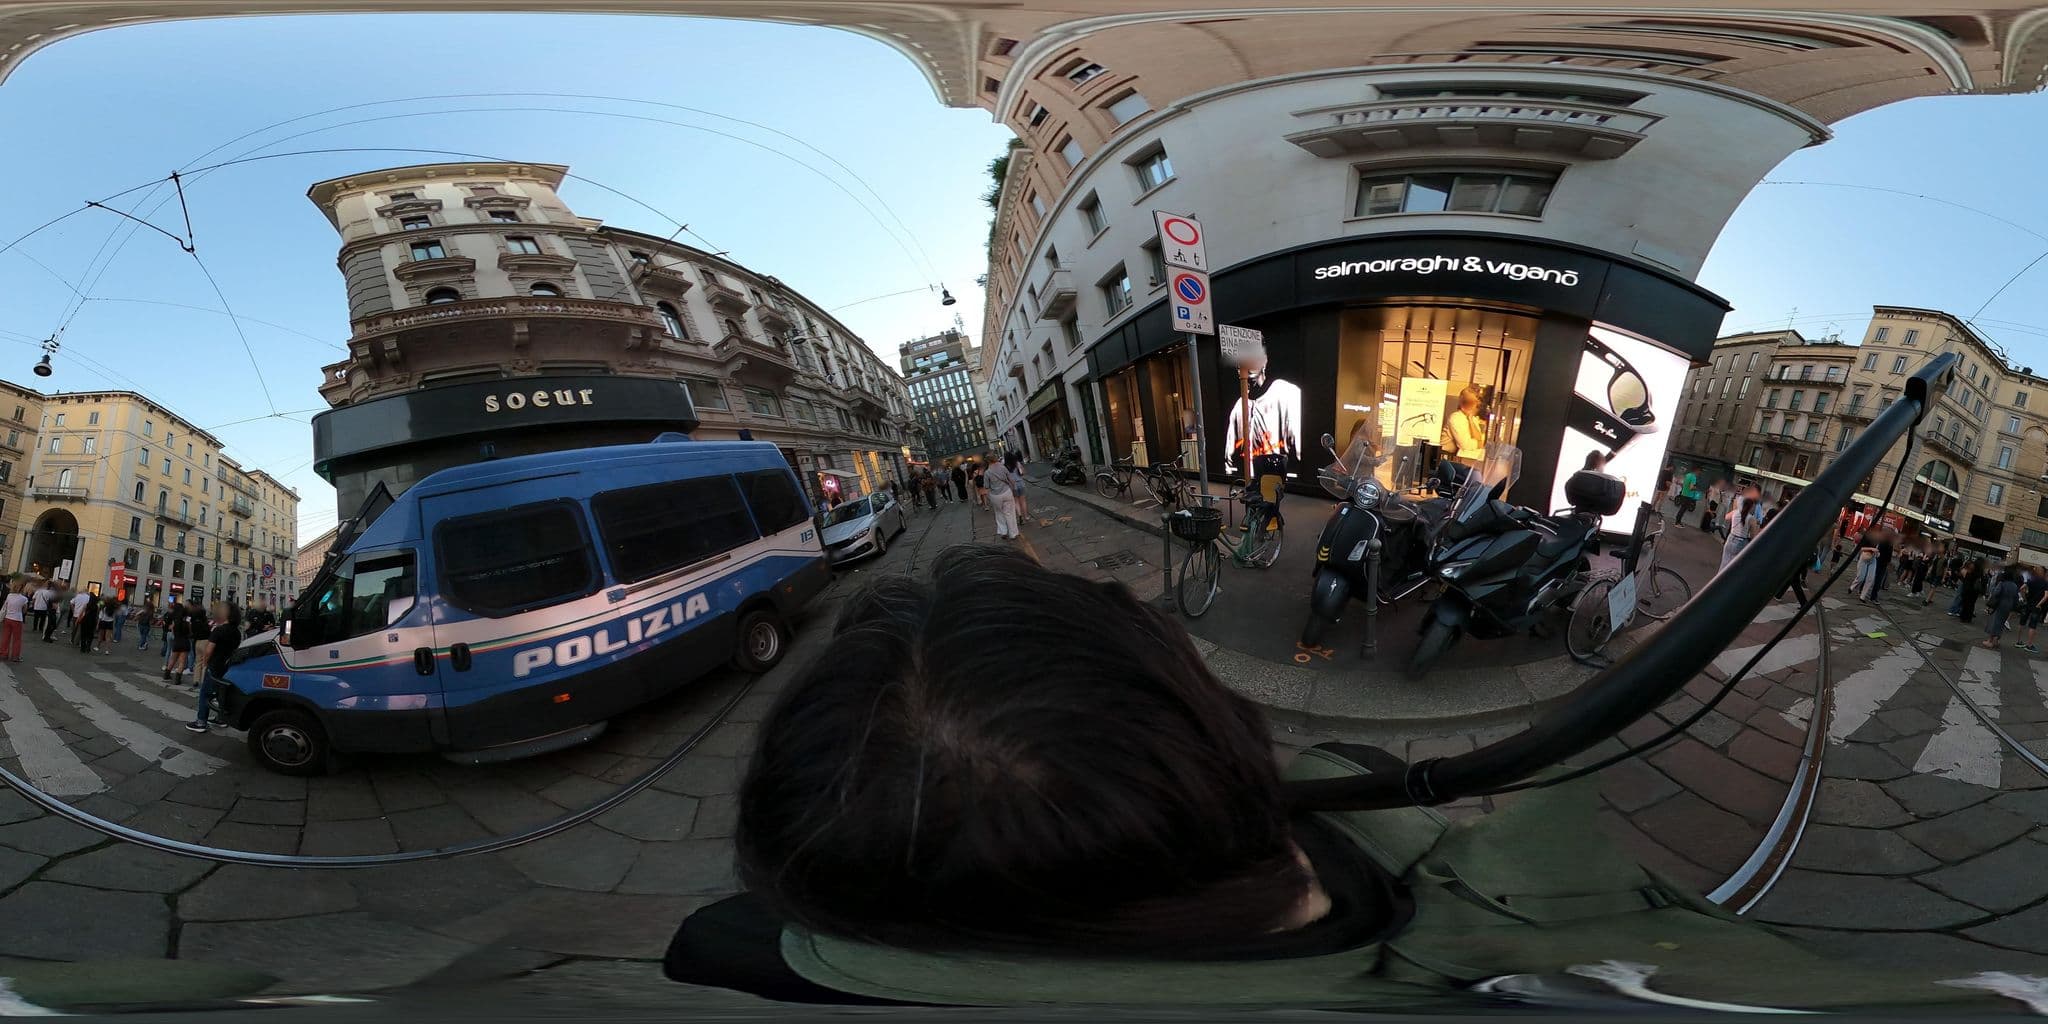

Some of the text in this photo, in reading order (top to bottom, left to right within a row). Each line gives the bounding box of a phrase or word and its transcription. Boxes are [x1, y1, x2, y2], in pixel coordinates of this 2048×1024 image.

[1314, 255, 1459, 279] salmoiraghi
[1462, 256, 1483, 272] &
[1220, 325, 1261, 341] ATTENZIONE
[485, 389, 593, 412] soeur
[801, 529, 813, 543] 113
[513, 592, 710, 677] POLIZIA
